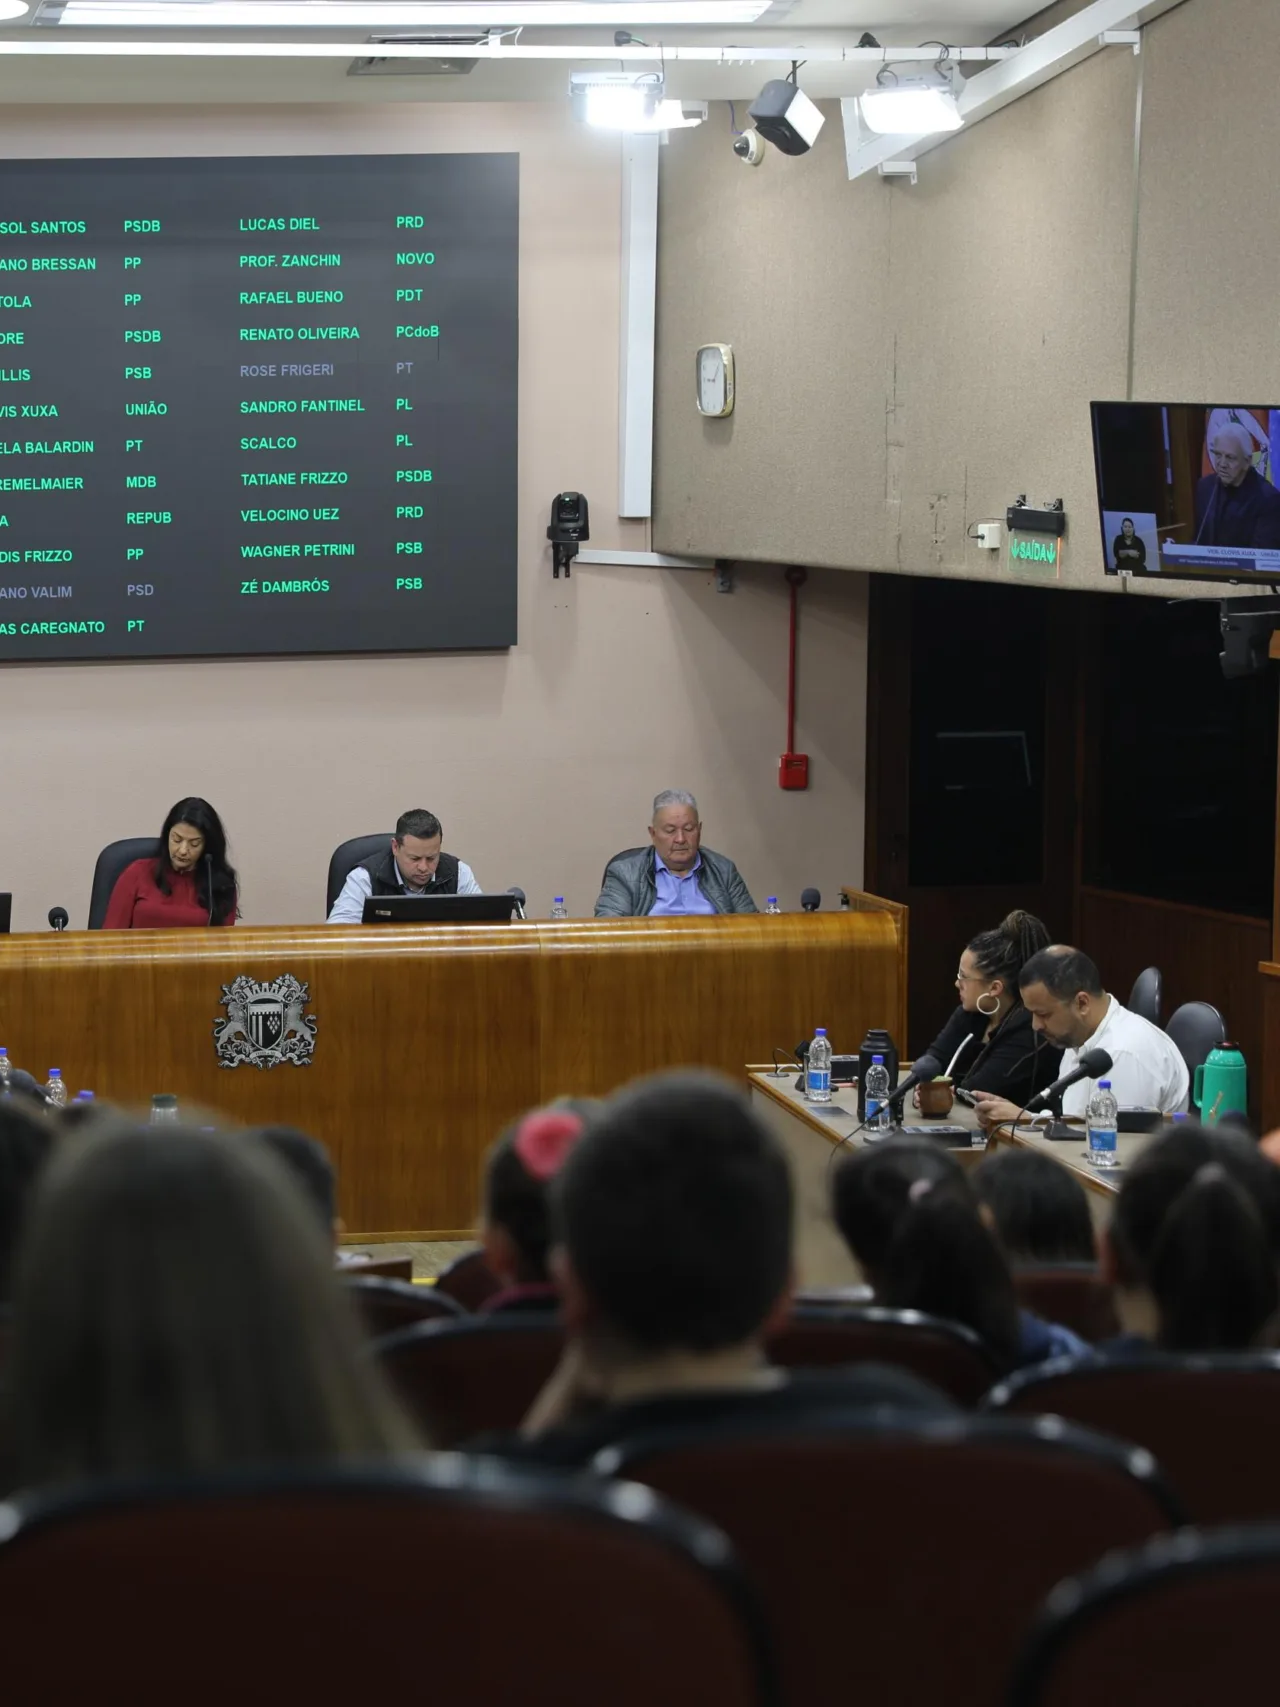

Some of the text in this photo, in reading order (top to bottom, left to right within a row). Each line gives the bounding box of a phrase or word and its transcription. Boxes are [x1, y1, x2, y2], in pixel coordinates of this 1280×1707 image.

[31, 221, 85, 233] SANTOS
[125, 220, 160, 232] PSDB
[240, 218, 319, 230] LUCAS DIEL
[396, 216, 424, 228] PRD
[32, 258, 95, 270] BRESSAN
[125, 257, 141, 268] PP
[240, 254, 340, 267] PROF. ZANCHIN
[396, 253, 434, 264] NOVO
[125, 294, 141, 305] PP
[240, 291, 343, 304] RAFAEL BUENO
[397, 289, 423, 301] PDT
[125, 331, 161, 342] PSDB
[240, 327, 359, 340] RENATO OLIVEIRA
[397, 326, 439, 337] PCdoB
[126, 367, 151, 378] PSB
[241, 364, 333, 376] ROSE FRIGERI
[397, 362, 413, 373] PT
[126, 401, 167, 415] UNIÃO
[241, 400, 365, 413] SANDRO FANTINEL
[397, 399, 412, 410] PL
[22, 405, 58, 417] XUXA
[126, 440, 143, 451] PT
[241, 437, 296, 449] SCALCO
[397, 435, 412, 446] PL
[26, 441, 93, 453] BALARDIN
[127, 476, 156, 487] MDB
[241, 472, 347, 485] TATIANE FRIZZO
[397, 470, 432, 482] PSDB
[127, 512, 171, 524] REPUB
[241, 508, 339, 521] VELOCINO UEZ
[397, 506, 423, 518] PRD
[241, 544, 354, 557] WAGNER PETRINI
[397, 542, 422, 553] PSB
[1019, 539, 1047, 562] SAÍDA
[25, 550, 72, 562] FRIZZO
[127, 549, 143, 560] PP
[128, 584, 153, 595] PSD
[241, 578, 329, 593] ZÉ DAMBRÓS
[397, 578, 422, 589] PSB
[31, 586, 72, 598] VALIM
[21, 621, 104, 634] CAREGNATO
[128, 620, 144, 631] PT
